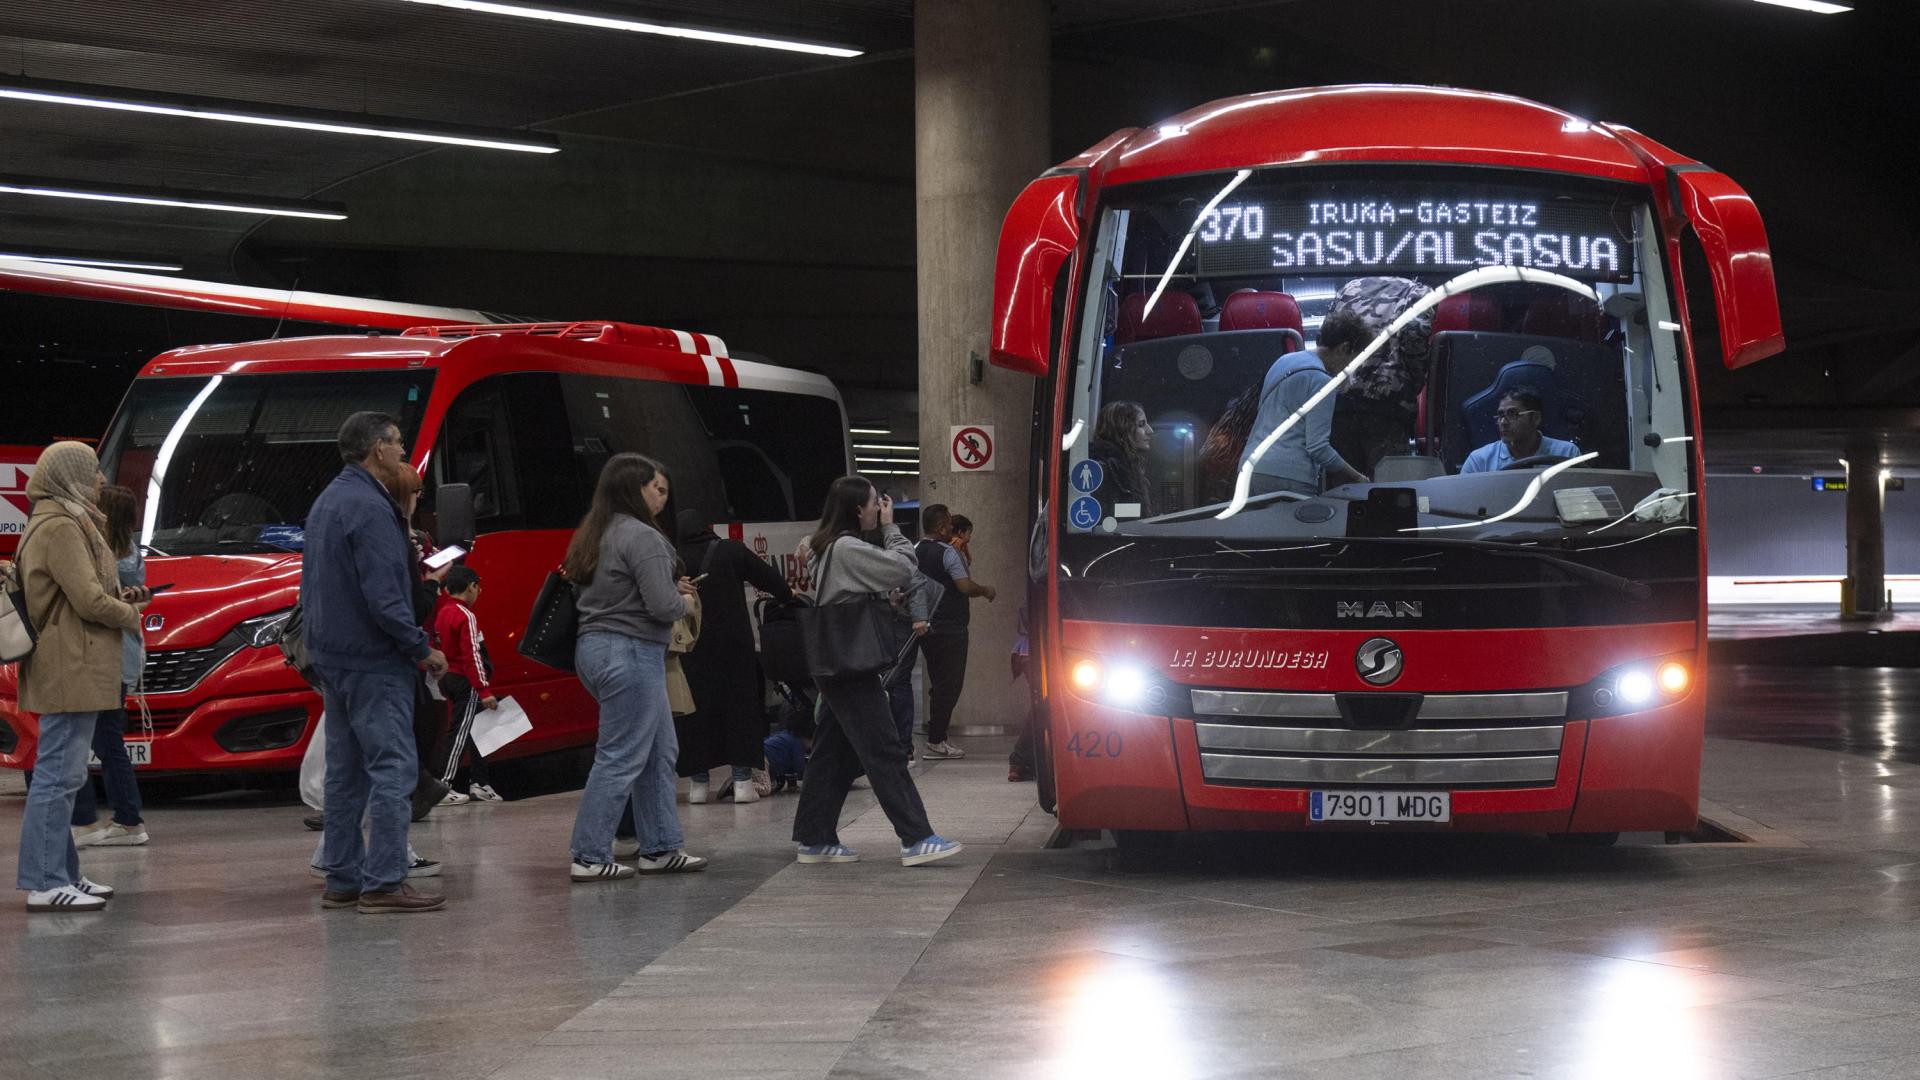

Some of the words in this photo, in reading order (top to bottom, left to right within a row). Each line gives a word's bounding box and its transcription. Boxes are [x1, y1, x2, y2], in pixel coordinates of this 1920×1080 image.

[1201, 206, 1263, 241] 370
[1337, 600, 1423, 618] MAN
[1169, 649, 1196, 668] LA
[1200, 650, 1329, 669] BURUNDESA
[126, 745, 147, 761] TR
[1067, 731, 1123, 758] 420
[1327, 794, 1385, 817] 7901
[1397, 795, 1443, 818] MDG
